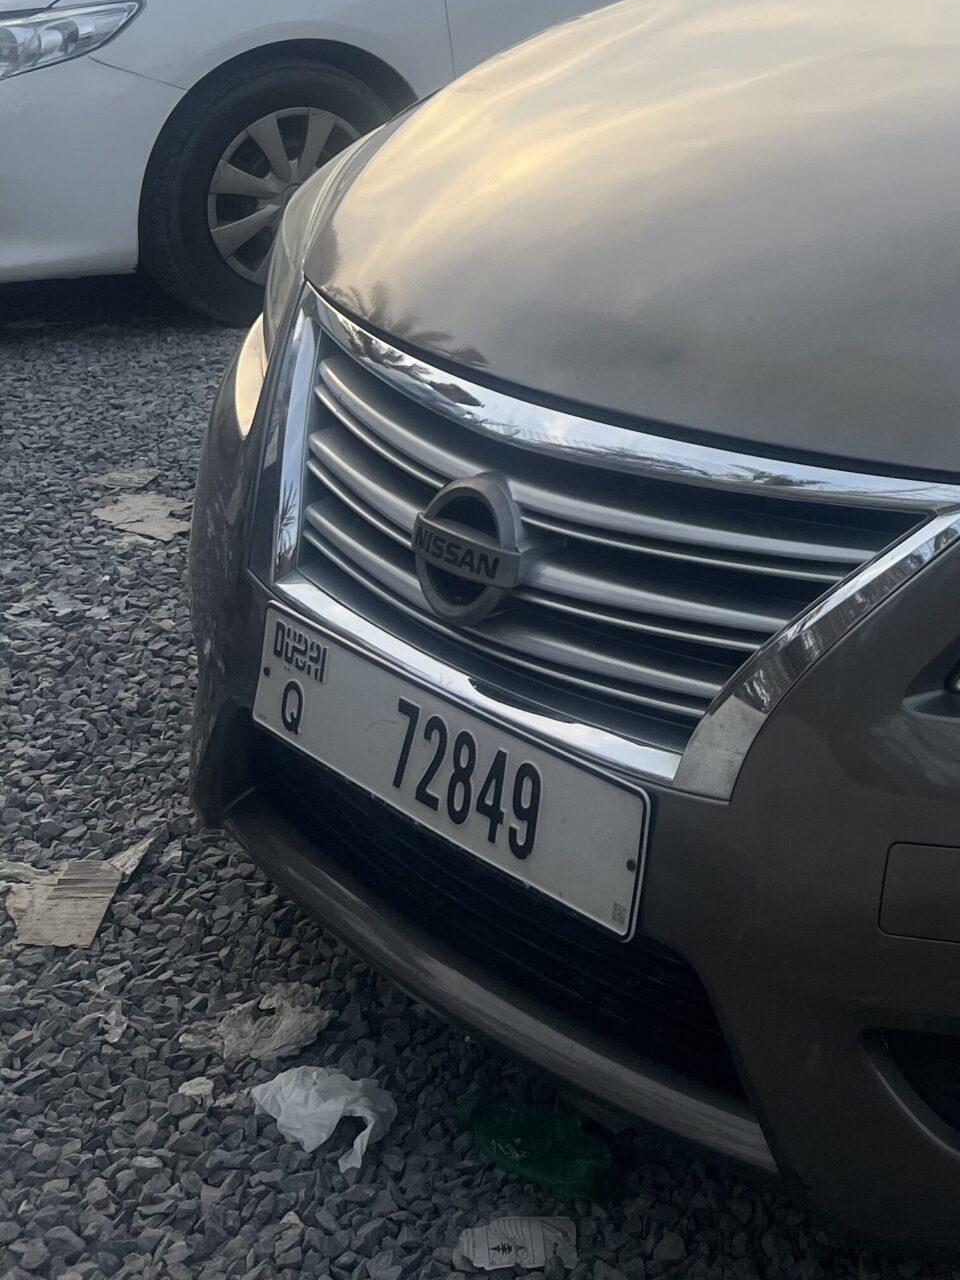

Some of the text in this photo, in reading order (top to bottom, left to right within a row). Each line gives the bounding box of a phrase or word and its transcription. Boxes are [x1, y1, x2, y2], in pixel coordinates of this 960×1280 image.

[414, 527, 500, 580] NISSAN
[281, 680, 304, 736] Q
[392, 697, 542, 860] 72849
